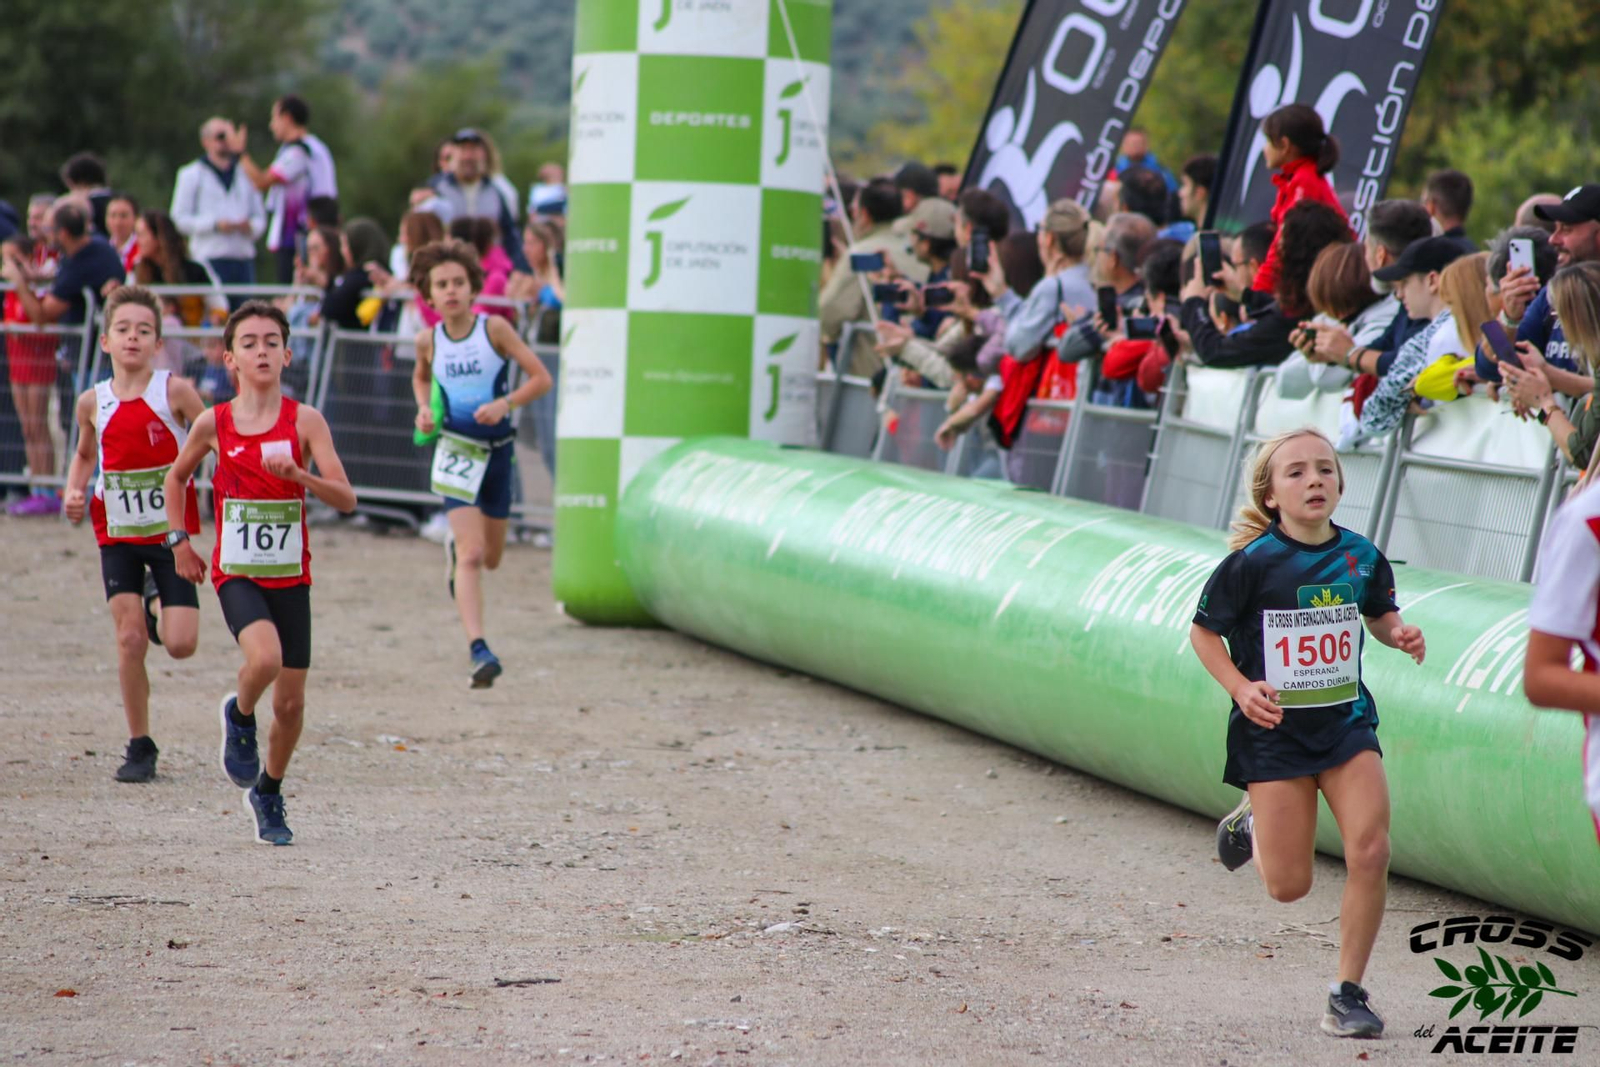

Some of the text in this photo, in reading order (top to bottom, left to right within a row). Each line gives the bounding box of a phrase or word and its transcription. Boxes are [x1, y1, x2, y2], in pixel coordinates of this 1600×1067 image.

[650, 112, 751, 128] DEPORTES
[445, 360, 482, 378] ISAAC
[118, 488, 165, 514] 116
[237, 524, 292, 550] 167
[1275, 613, 1293, 628] CROSS
[1294, 609, 1335, 628] INTERNACIONAL
[1275, 630, 1351, 667] 1506
[1294, 666, 1339, 677] ESPERANZA
[1284, 681, 1325, 690] CAMPOS
